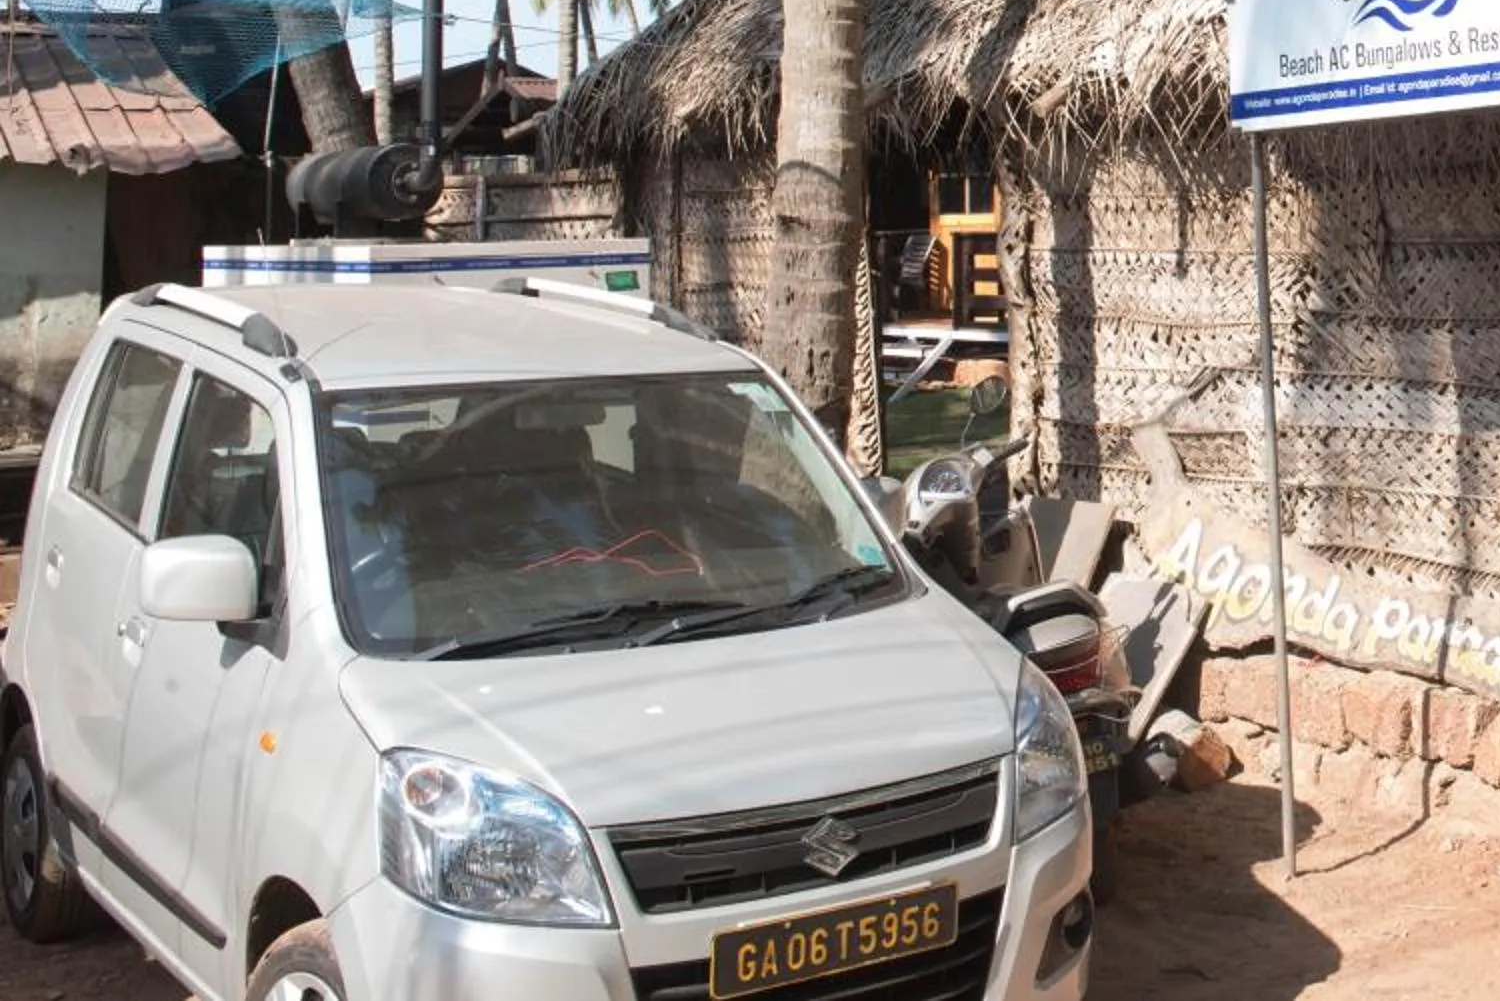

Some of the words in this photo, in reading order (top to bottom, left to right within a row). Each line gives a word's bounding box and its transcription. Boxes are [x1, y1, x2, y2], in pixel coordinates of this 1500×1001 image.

[1279, 53, 1323, 78] Beach
[1329, 46, 1350, 72] AC
[1355, 38, 1442, 70] Bungalows
[1448, 30, 1462, 55] &
